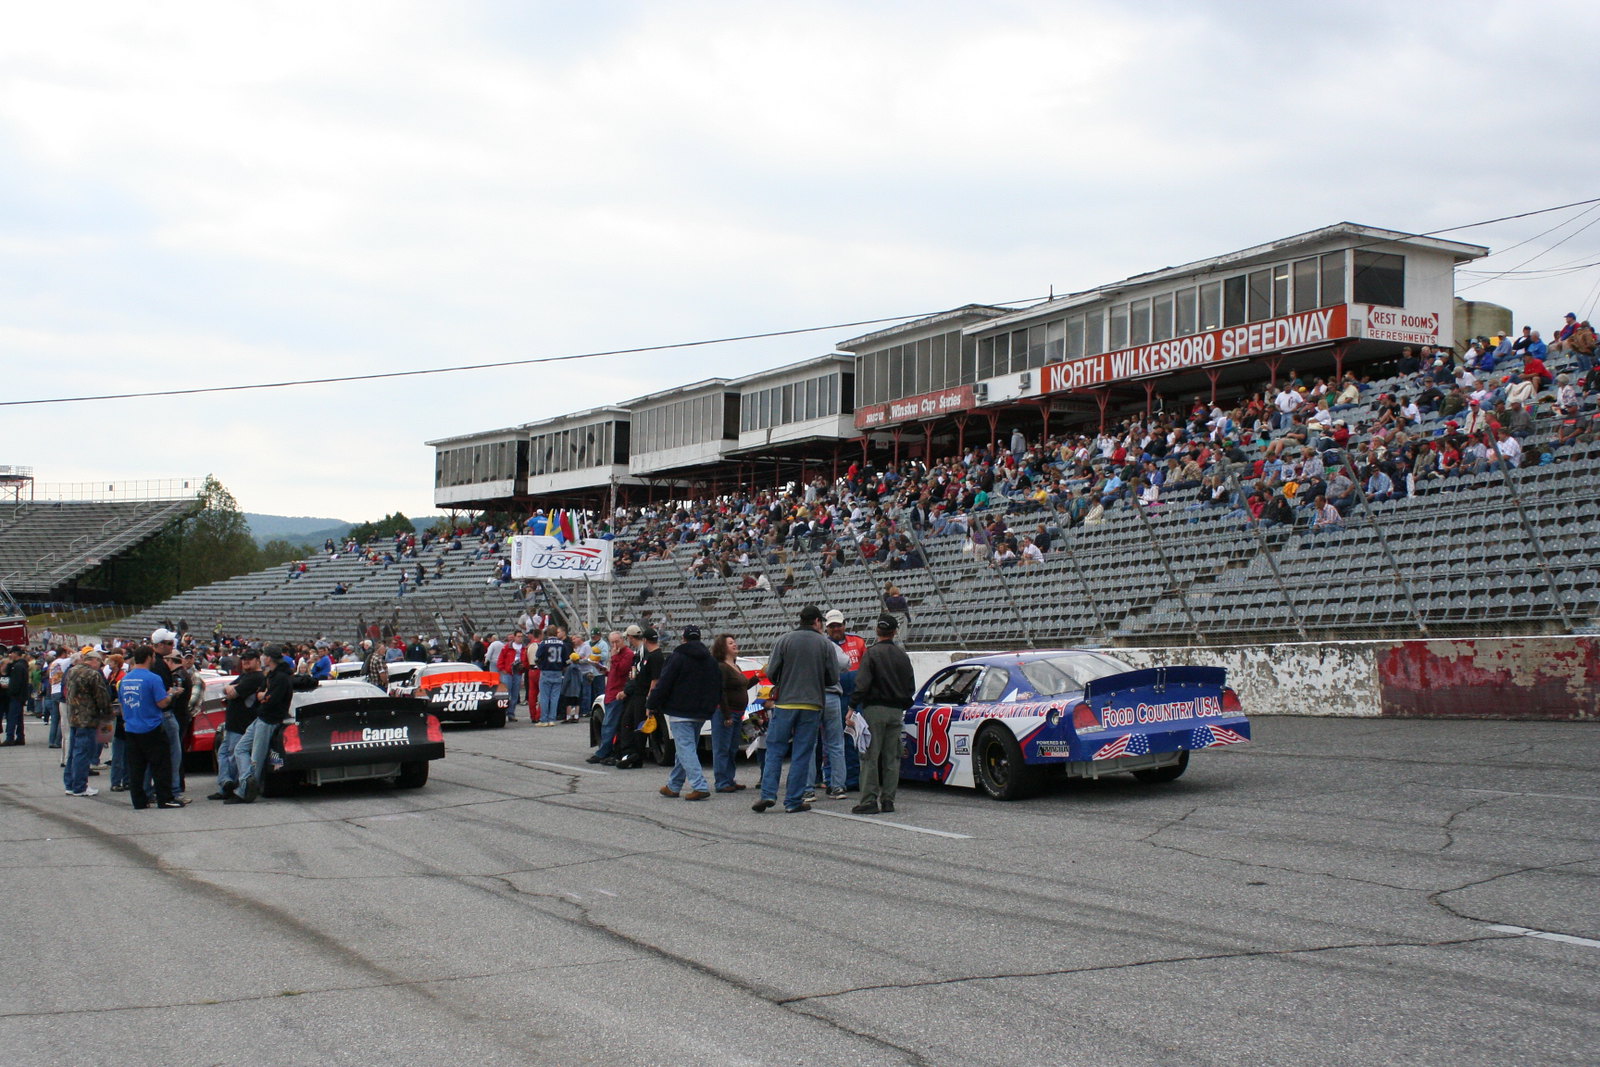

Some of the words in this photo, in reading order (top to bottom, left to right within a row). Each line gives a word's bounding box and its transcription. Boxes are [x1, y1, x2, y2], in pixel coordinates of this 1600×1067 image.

[1373, 312, 1397, 325] REST
[1401, 315, 1434, 329] ROOMS
[1369, 329, 1436, 345] REFRESHMENTS
[1050, 356, 1105, 391] NORTH
[1110, 333, 1216, 379] WILKESBORO
[1221, 309, 1334, 358] SPEEDWAY
[921, 398, 936, 414] Cup
[940, 393, 962, 409] Series
[548, 646, 562, 663] 31
[440, 682, 481, 694] STRUT
[432, 691, 493, 703] MASTERS
[443, 700, 478, 711] .COM
[1102, 705, 1134, 728] FOOD
[1137, 701, 1194, 724] COUNTRY
[1194, 696, 1222, 718] USA
[914, 706, 953, 766] 18
